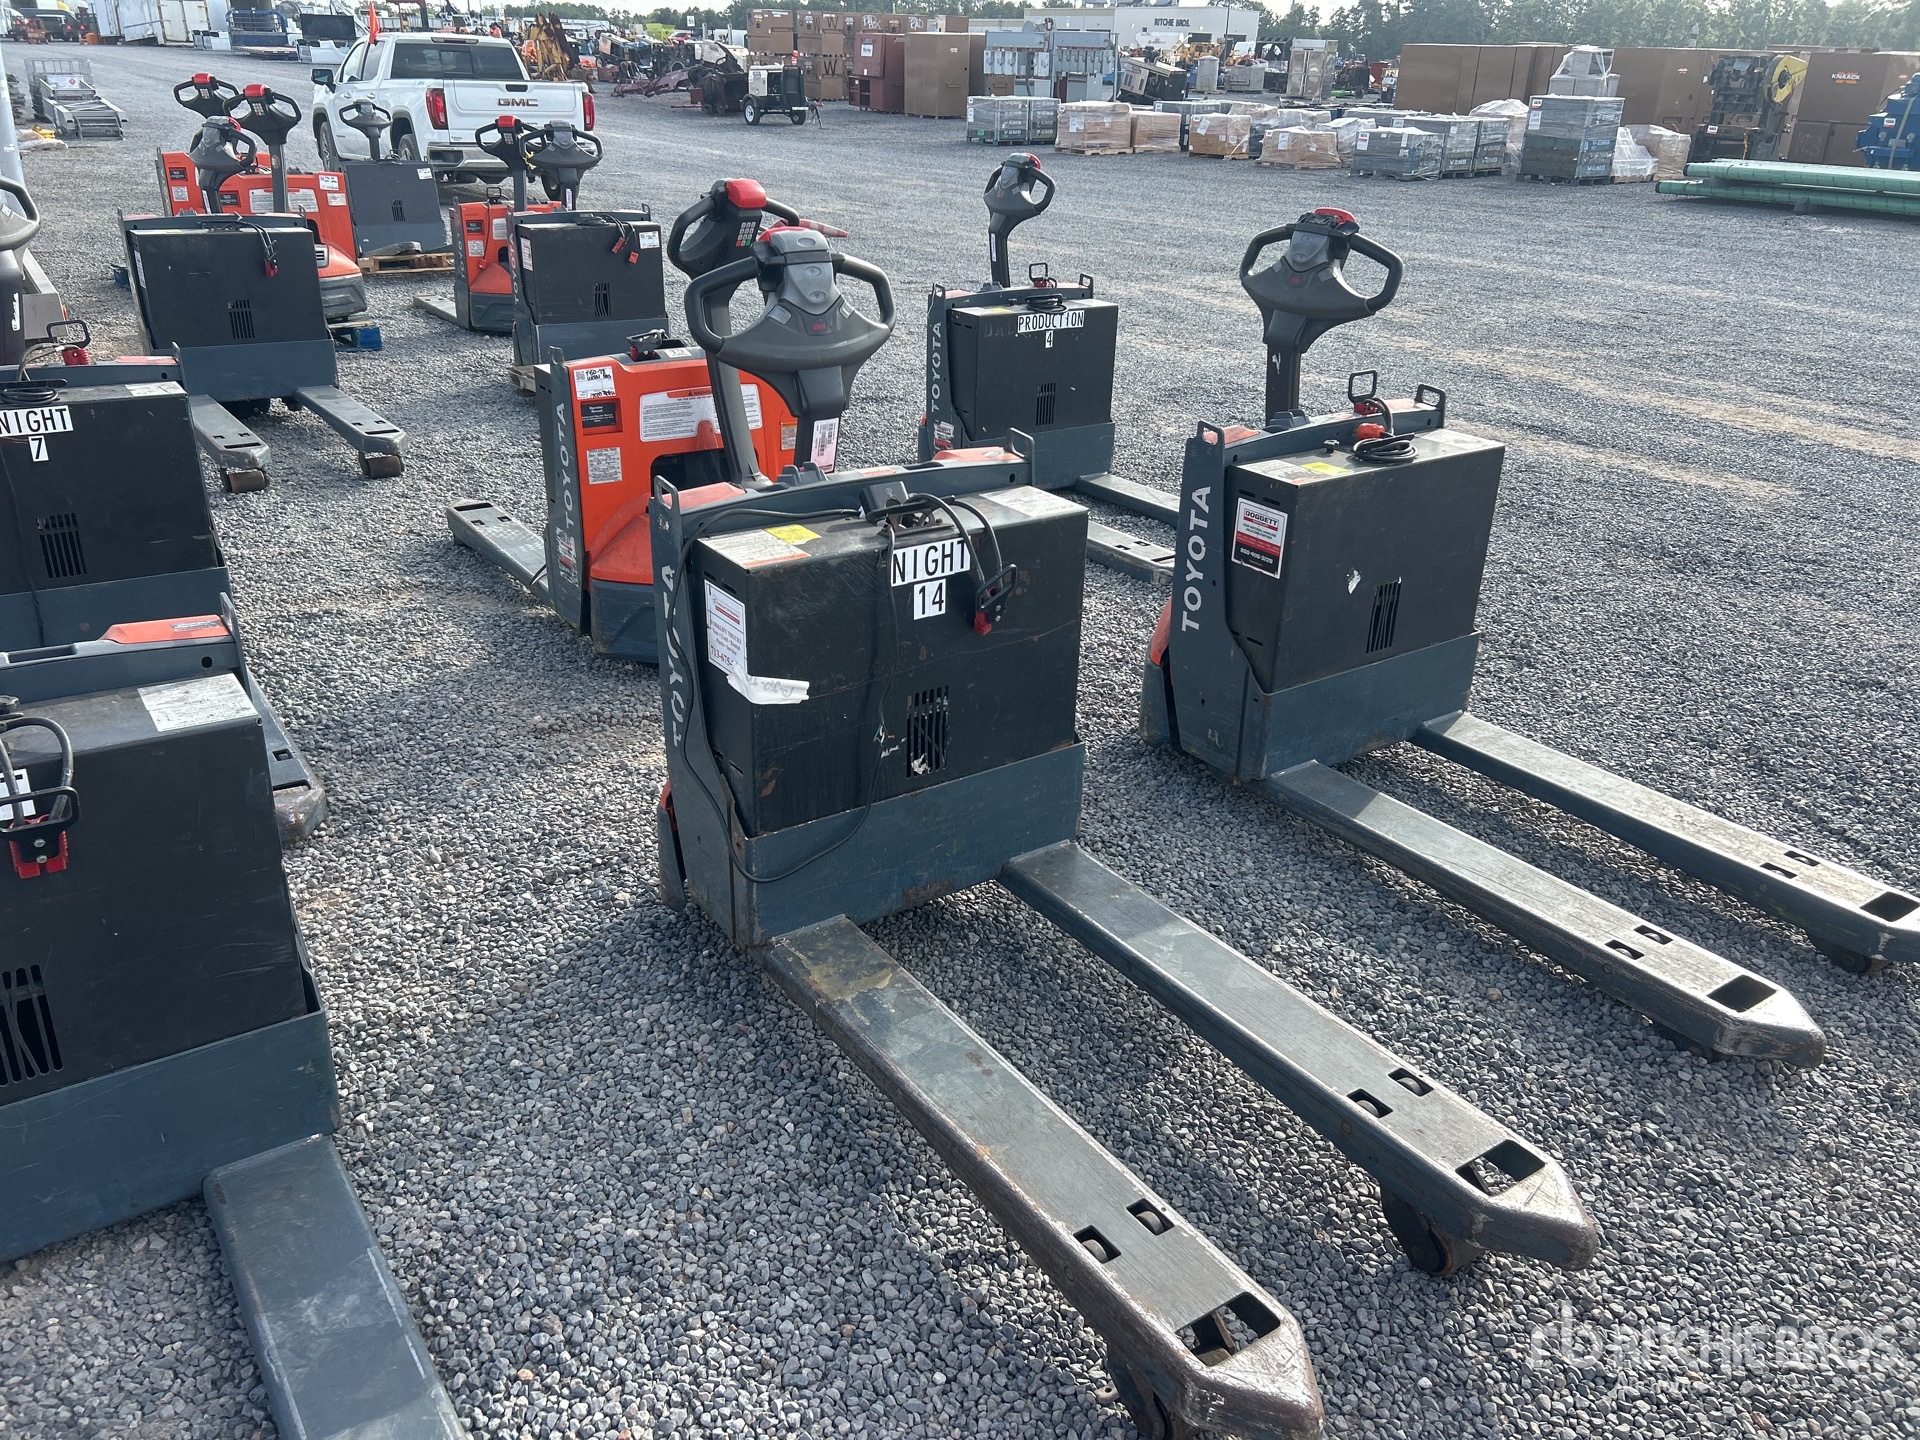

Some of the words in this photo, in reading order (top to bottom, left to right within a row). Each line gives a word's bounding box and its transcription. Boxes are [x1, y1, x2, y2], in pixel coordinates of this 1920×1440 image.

[1154, 18, 1174, 26] RITCHIE
[498, 98, 539, 107] GMC
[509, 233, 520, 304] TOYOTA
[1018, 311, 1084, 332] PRODUCTION
[1046, 333, 1053, 346] 4
[932, 321, 942, 413] TOYOTA
[0, 408, 66, 434] NIGHT
[31, 438, 42, 459] 7
[557, 403, 574, 529] TOYOTA
[1245, 511, 1278, 526] DOGGETT
[893, 539, 969, 584] NIGHT
[1182, 486, 1210, 632] TOYOTA
[918, 580, 945, 614] 14
